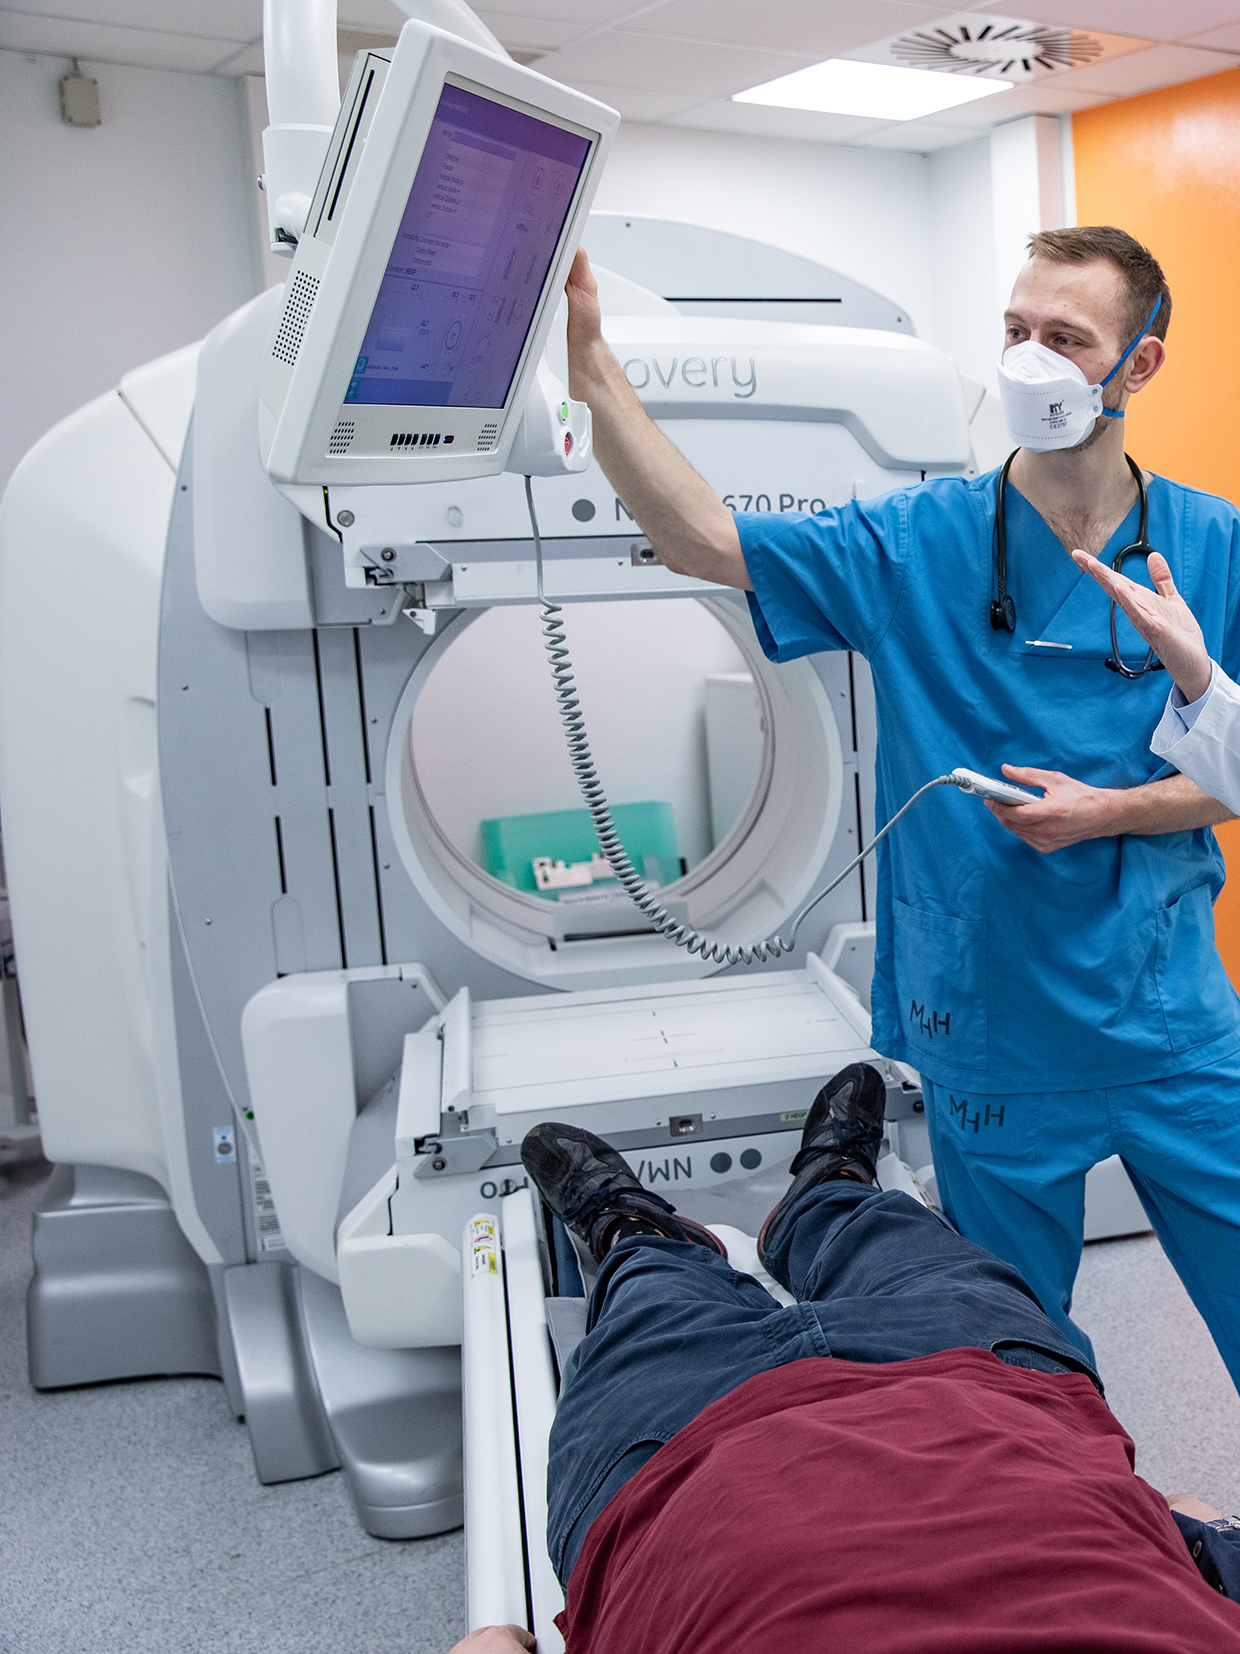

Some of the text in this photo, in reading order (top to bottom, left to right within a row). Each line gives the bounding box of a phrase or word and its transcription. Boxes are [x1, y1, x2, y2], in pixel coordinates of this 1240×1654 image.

[624, 356, 758, 399] overy
[779, 493, 827, 515] Pro
[909, 999, 951, 1039] MHH
[949, 1093, 1006, 1134] MHH
[637, 1156, 693, 1184] NM/
